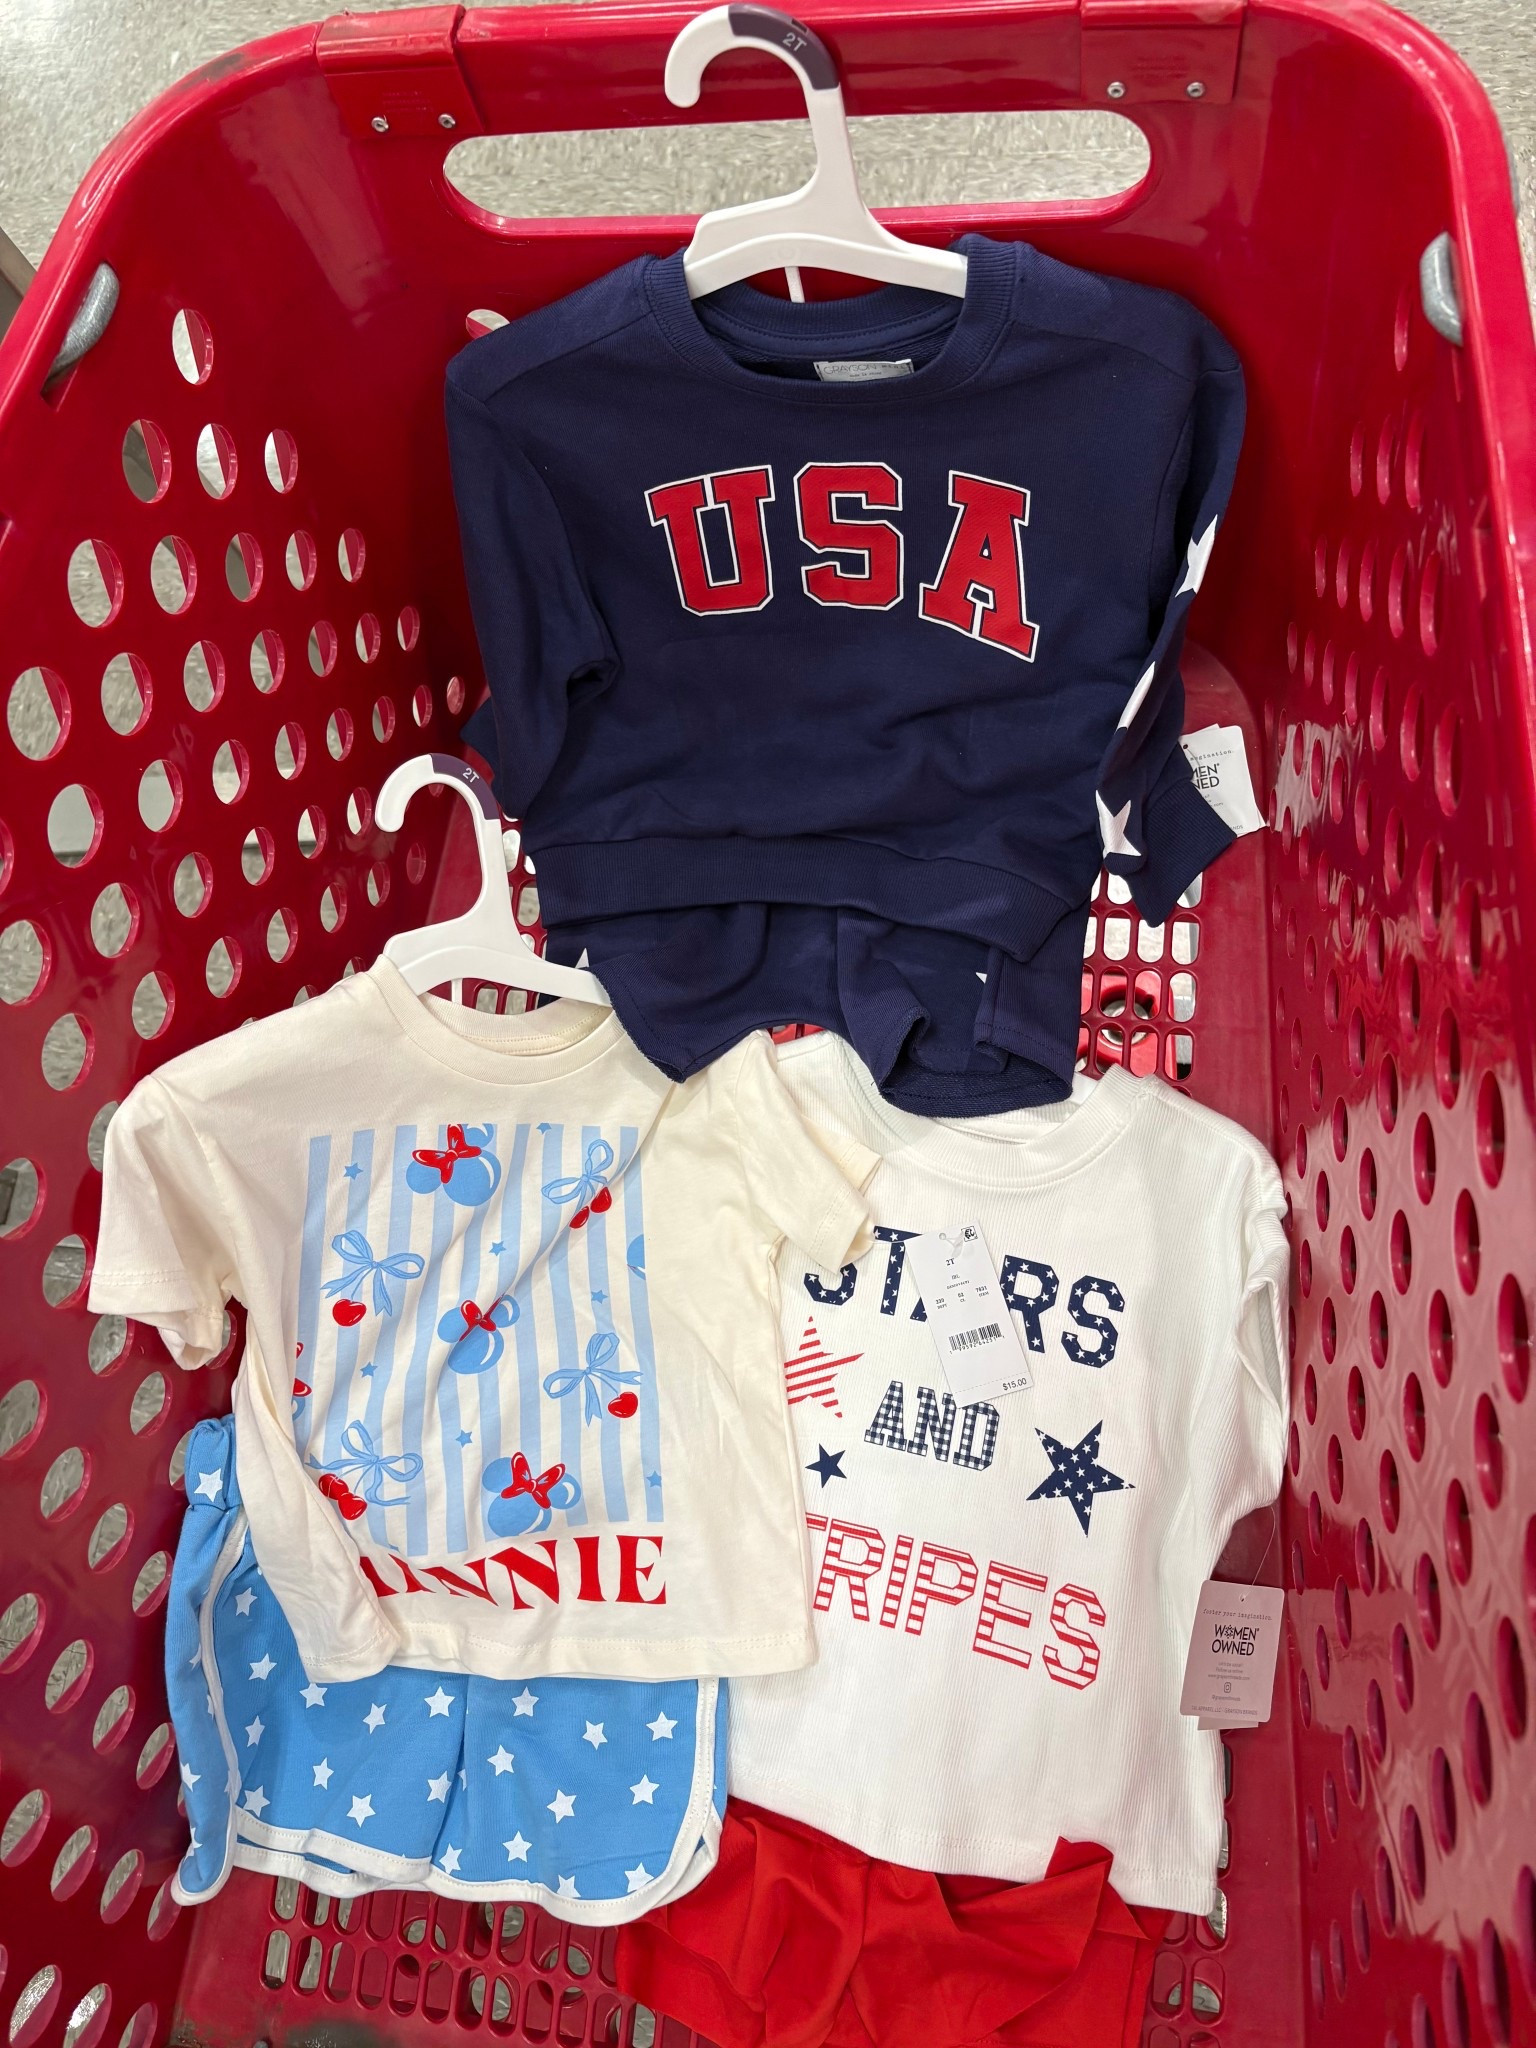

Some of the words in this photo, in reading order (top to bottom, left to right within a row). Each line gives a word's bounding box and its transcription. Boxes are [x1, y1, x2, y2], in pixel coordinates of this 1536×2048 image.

[782, 32, 807, 52] 2T
[644, 462, 1040, 663] USA
[462, 767, 480, 783] 2T
[946, 1257, 955, 1266] 2T
[804, 1225, 1125, 1369] TRS
[1002, 1377, 1028, 1391] $15.00
[864, 1380, 1001, 1471] AND
[1211, 1639, 1255, 1656] OWNED
